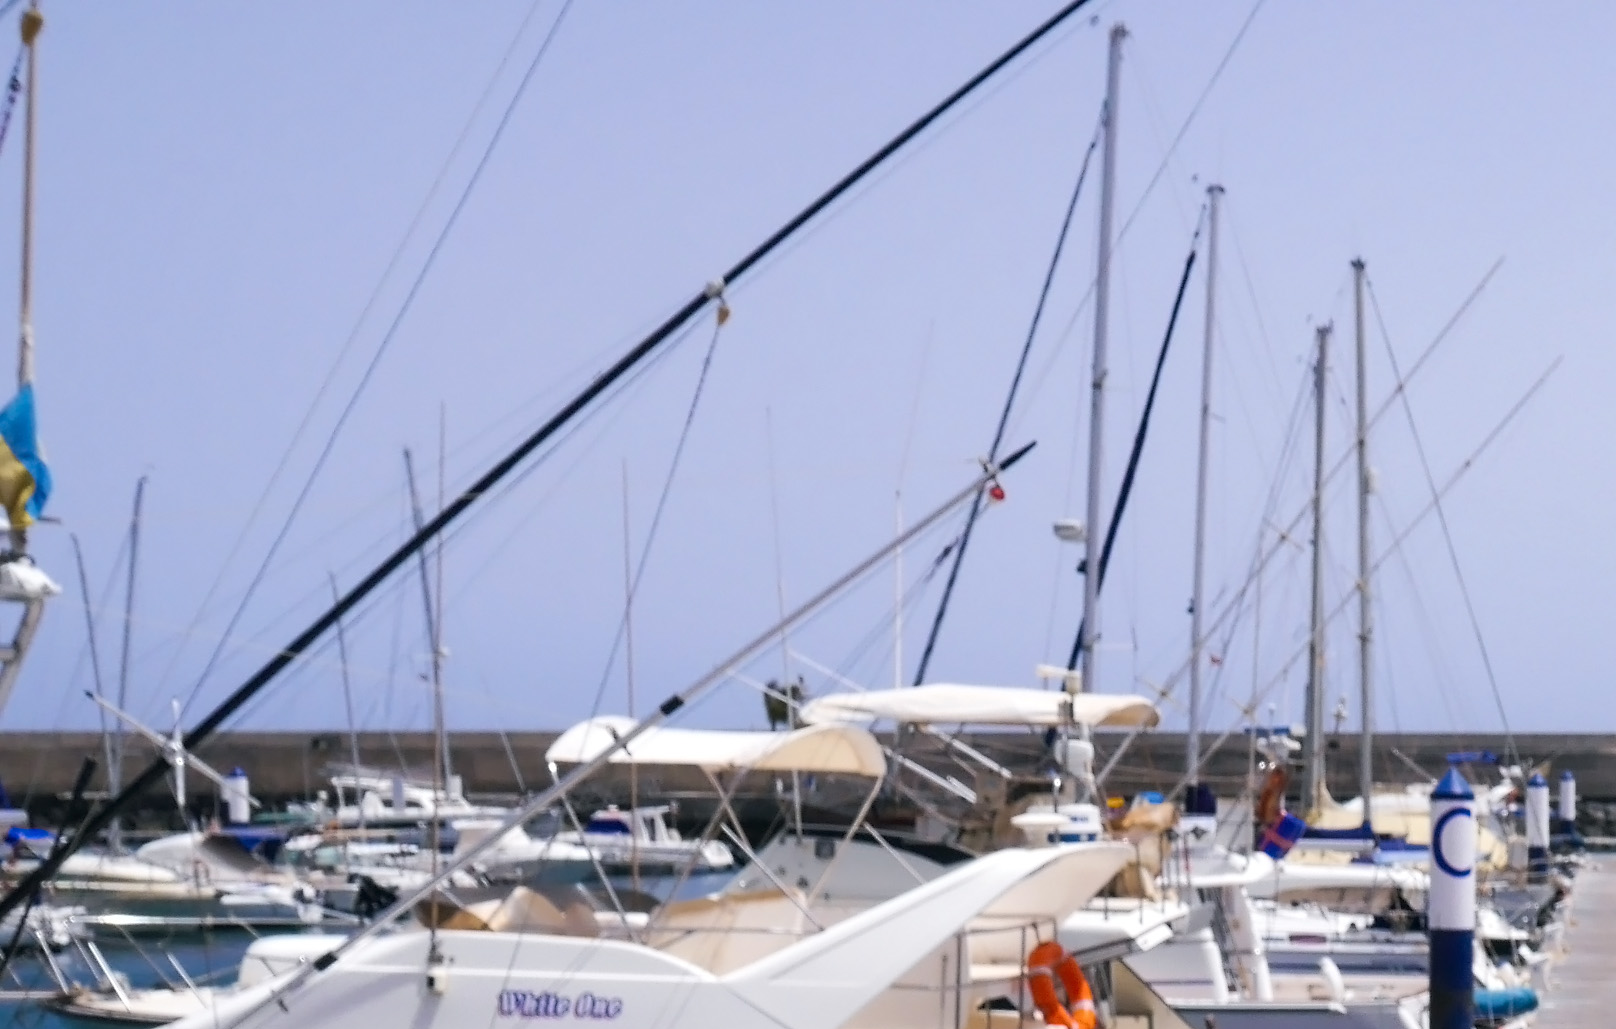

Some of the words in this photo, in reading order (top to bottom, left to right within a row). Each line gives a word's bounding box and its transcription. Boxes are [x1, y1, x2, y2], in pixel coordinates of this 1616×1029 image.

[1432, 805, 1471, 877] C
[498, 989, 570, 1017] White
[574, 990, 622, 1018] One
